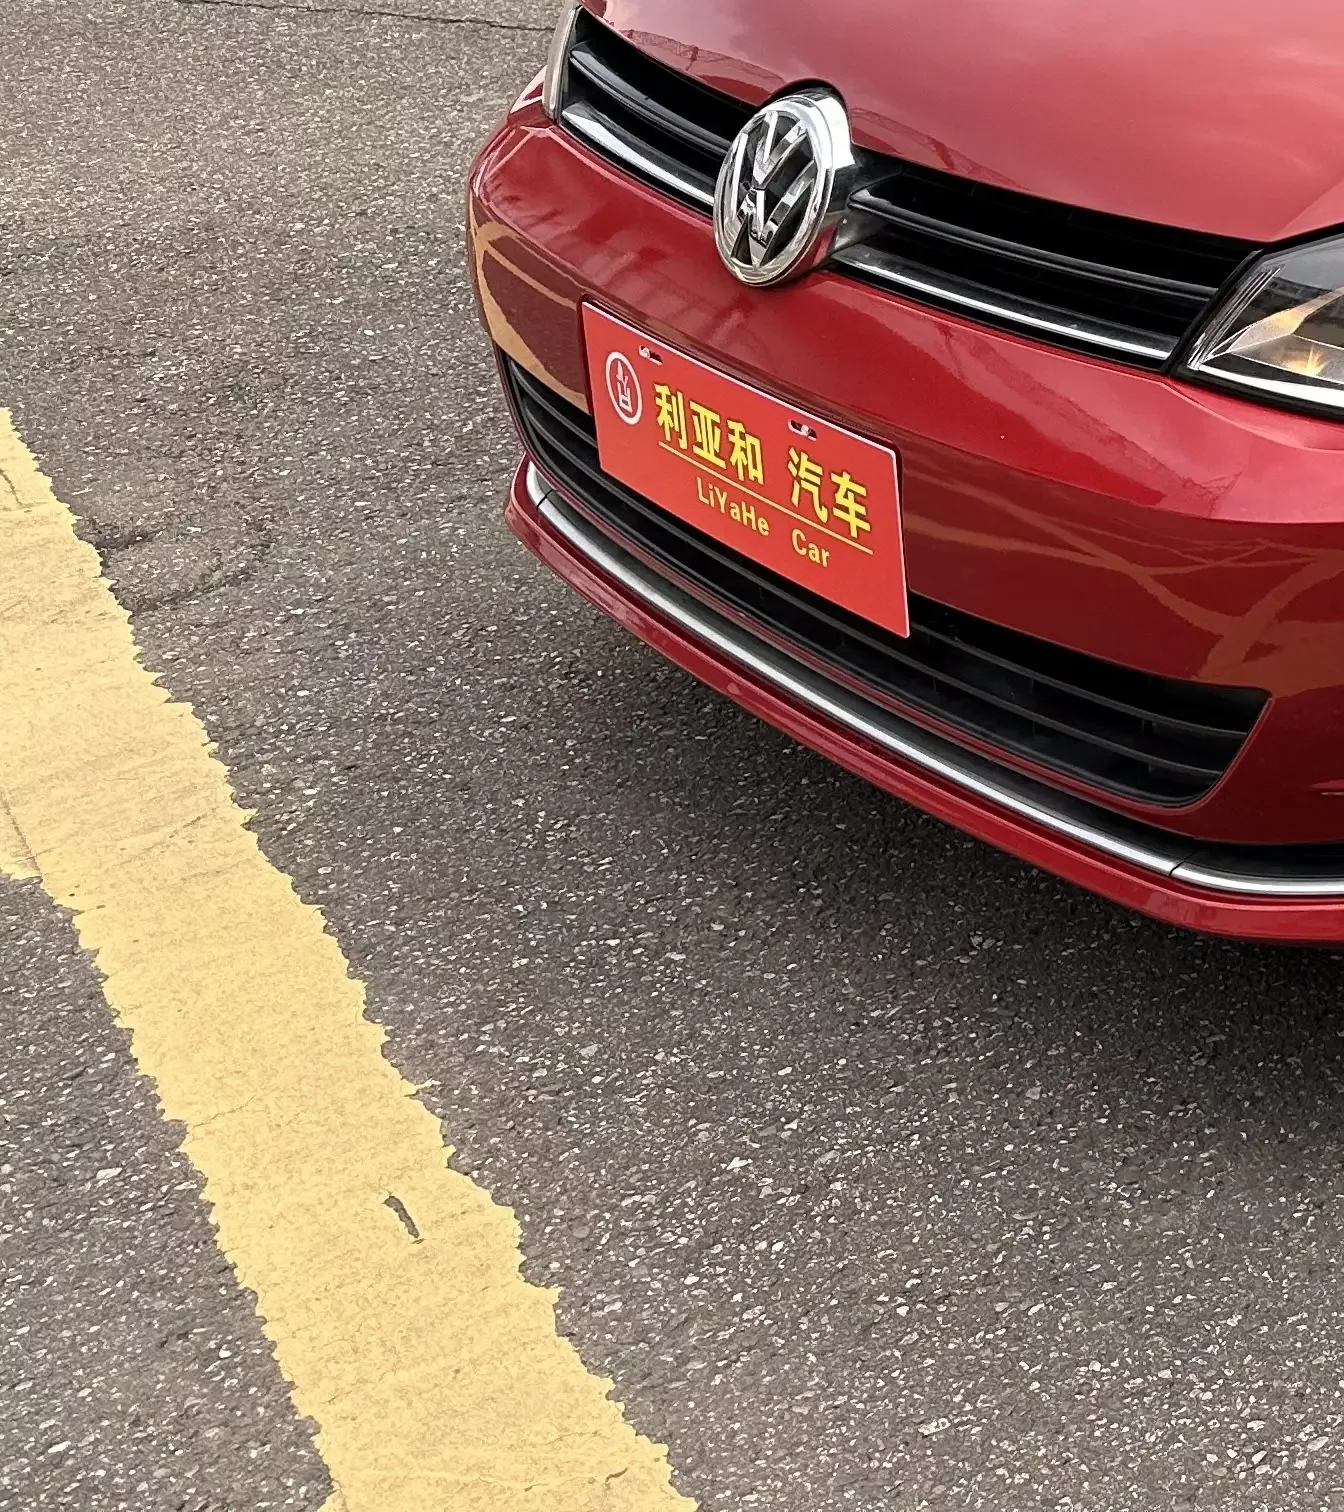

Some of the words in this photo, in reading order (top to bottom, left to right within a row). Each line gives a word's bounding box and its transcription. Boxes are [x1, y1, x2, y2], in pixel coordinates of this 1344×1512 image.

[653, 383, 766, 486] 利亚和
[786, 447, 872, 539] 汽车
[695, 476, 770, 536] LiYaHe
[791, 528, 830, 567] Car
